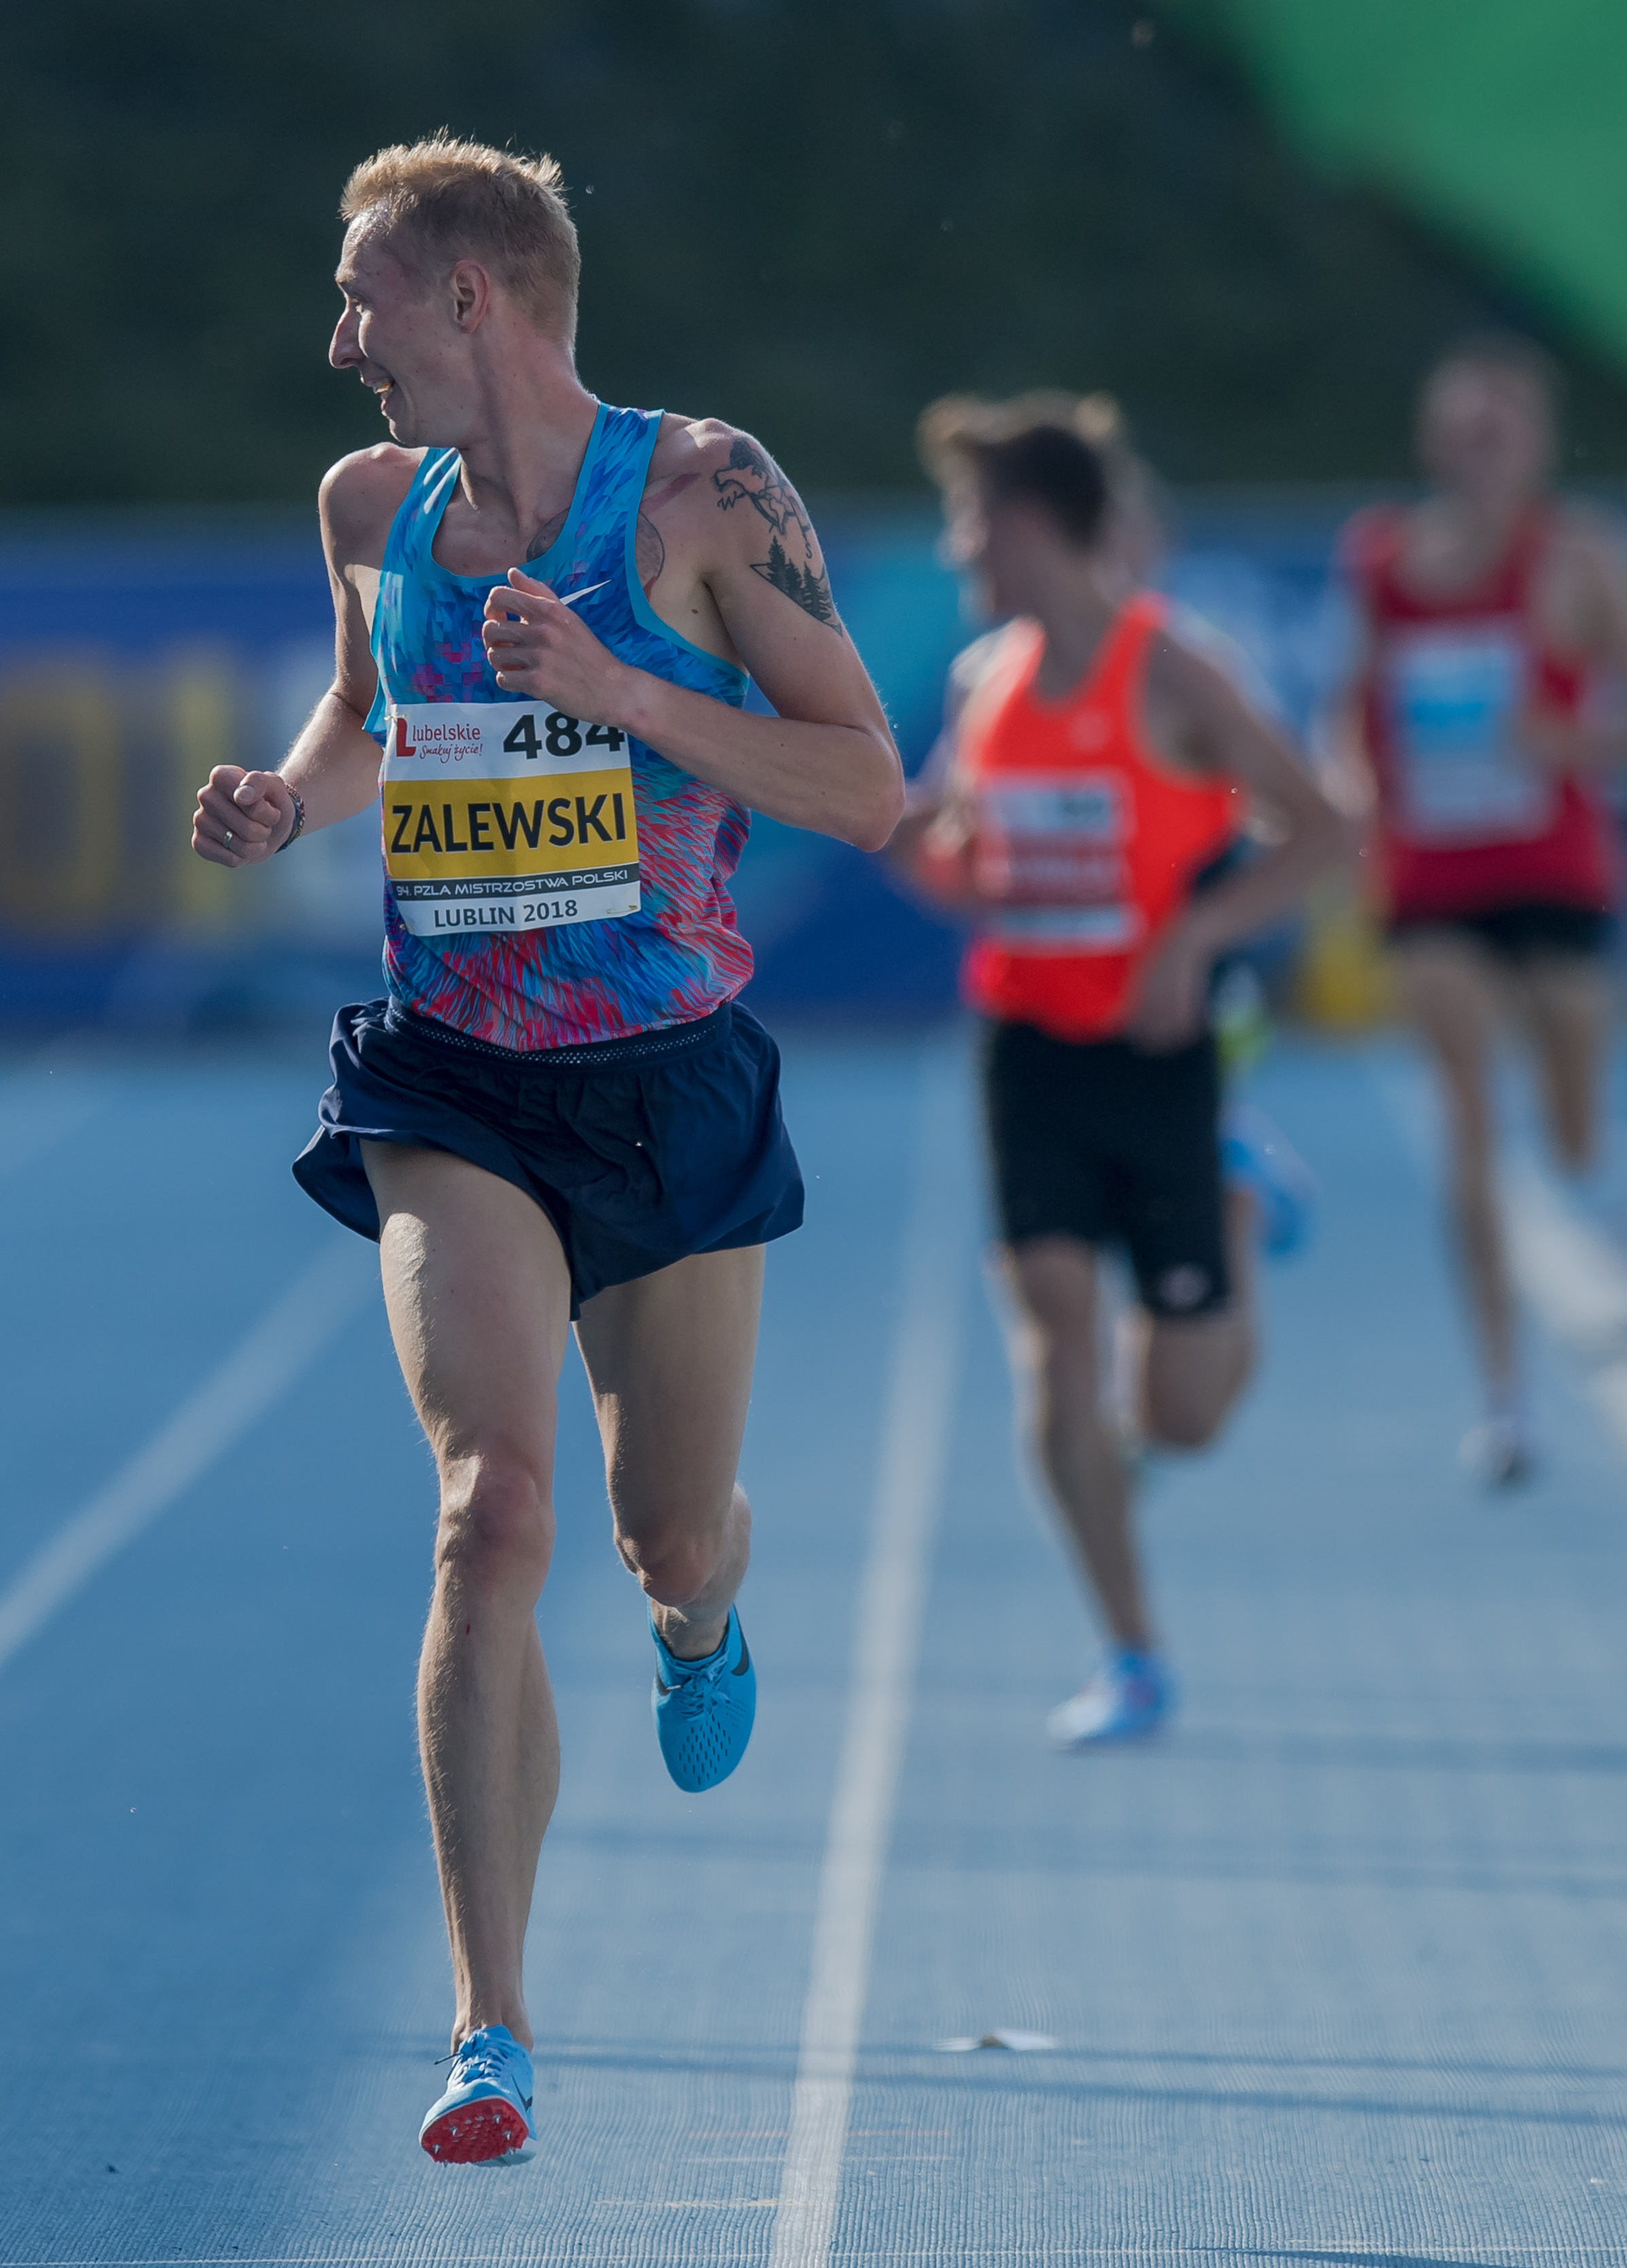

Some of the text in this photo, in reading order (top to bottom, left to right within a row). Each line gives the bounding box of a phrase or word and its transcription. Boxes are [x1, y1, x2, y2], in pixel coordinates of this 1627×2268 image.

[503, 711, 625, 760] 484
[391, 793, 626, 853] ZALEWSKI
[397, 870, 628, 896] 94. PZLA MISTRZOSTWA POLSKI
[434, 900, 577, 927] LUBLIN 2018
